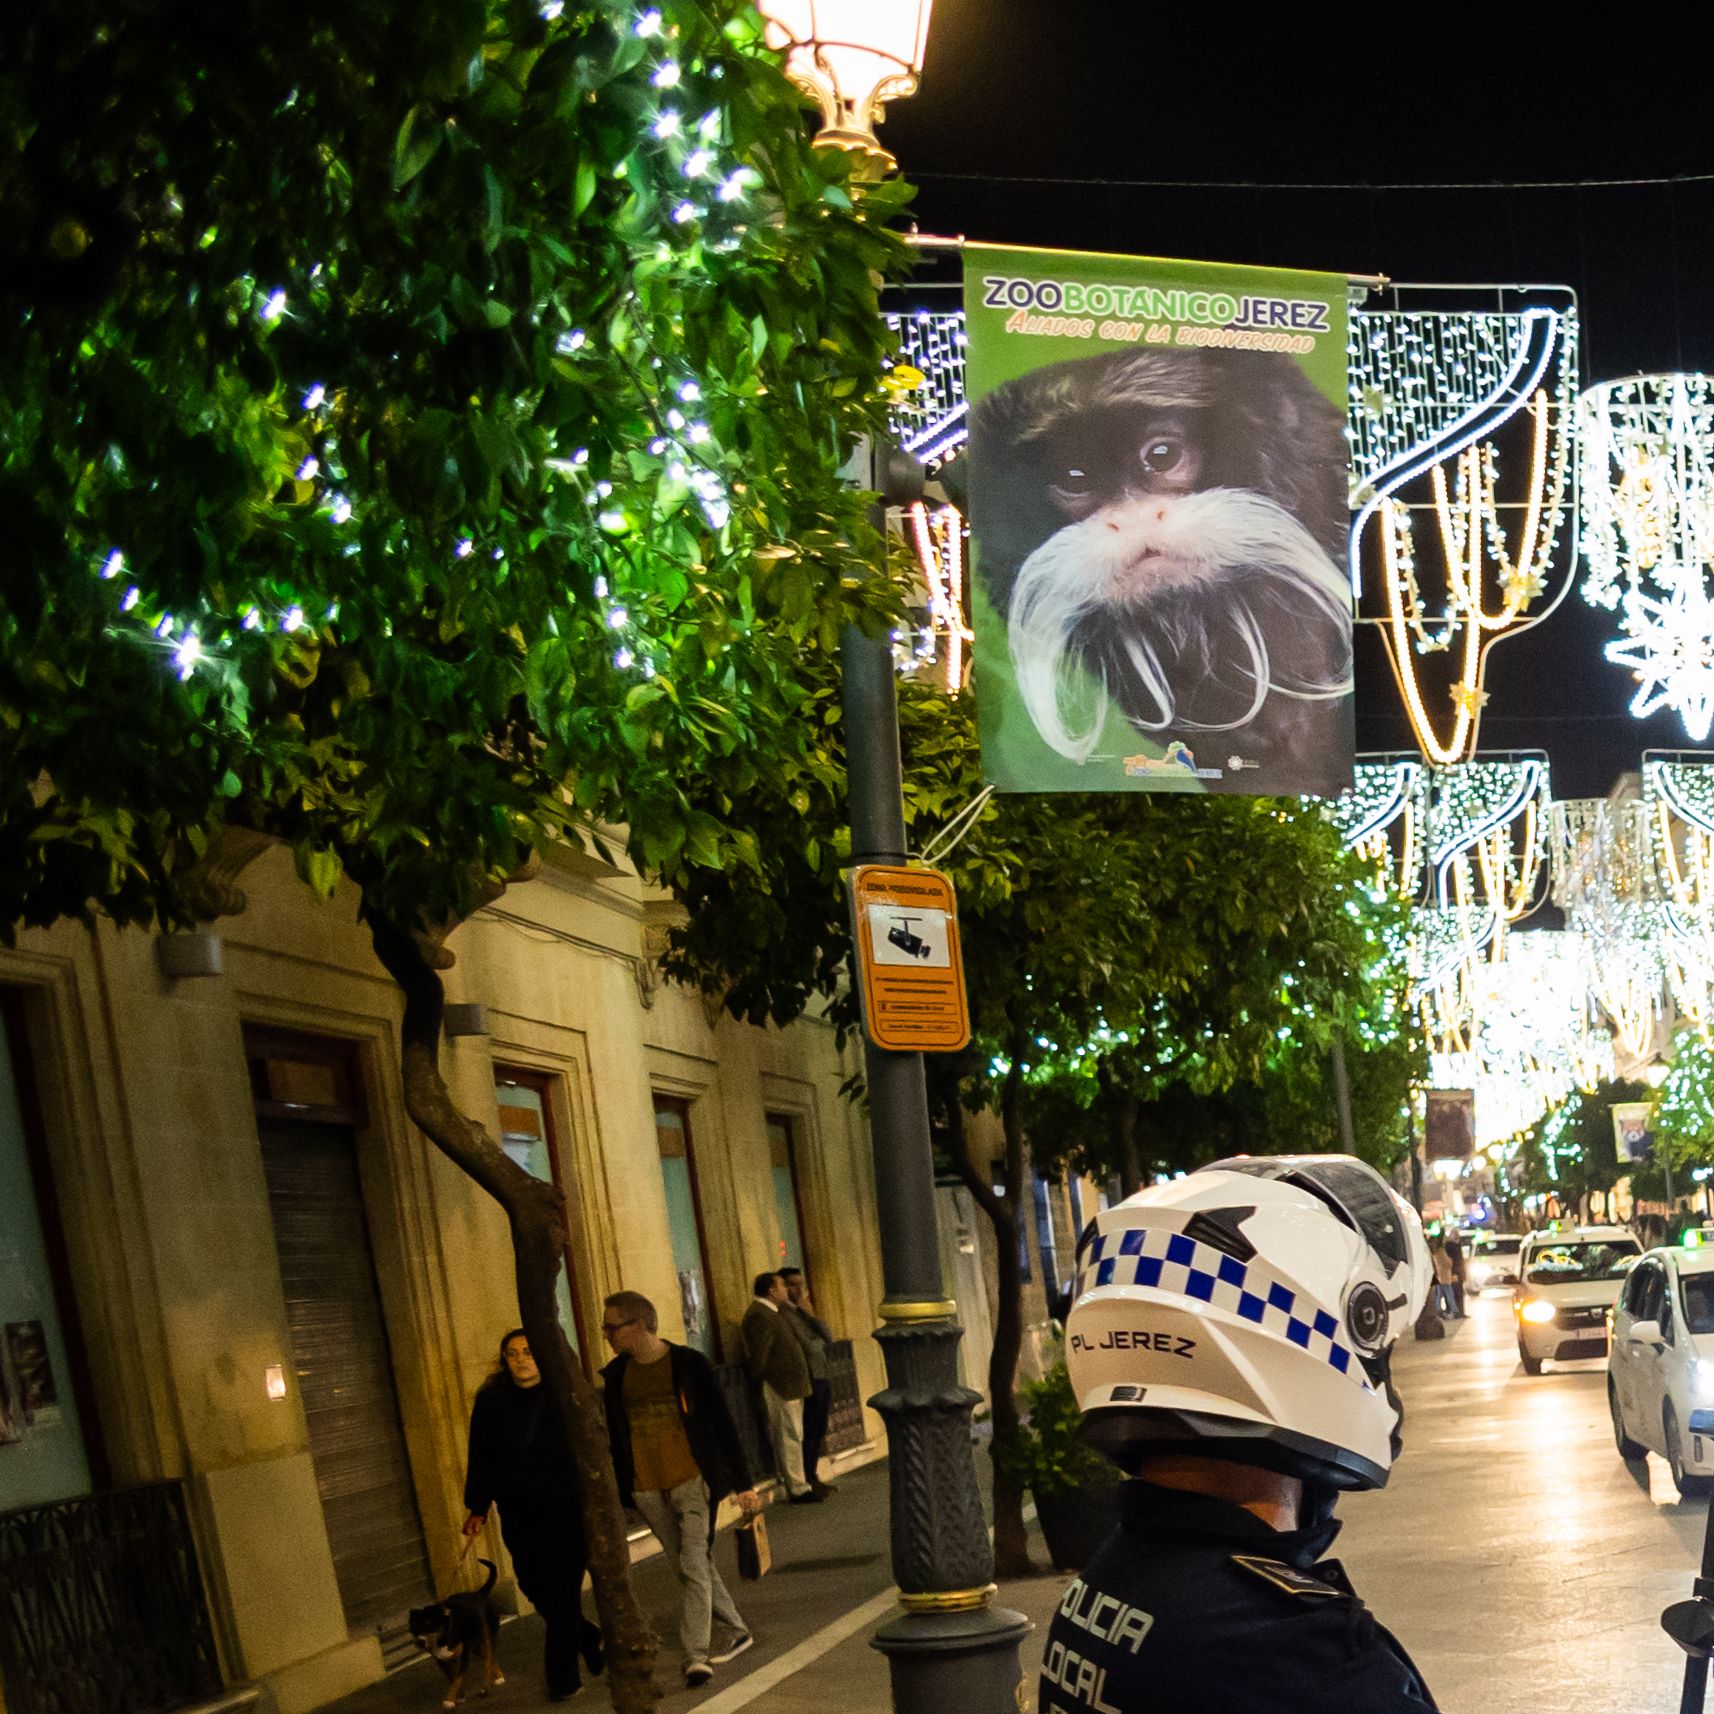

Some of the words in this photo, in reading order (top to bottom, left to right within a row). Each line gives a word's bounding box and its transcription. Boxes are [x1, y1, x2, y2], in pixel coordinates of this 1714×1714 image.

[1099, 320, 1141, 343] CON
[1145, 324, 1172, 344] LA
[1174, 326, 1317, 354] BIODIVERSIDAD
[1070, 1333, 1095, 1354] PL
[1099, 1330, 1197, 1359] JEREZ
[1060, 1577, 1155, 1655] OLICIA
